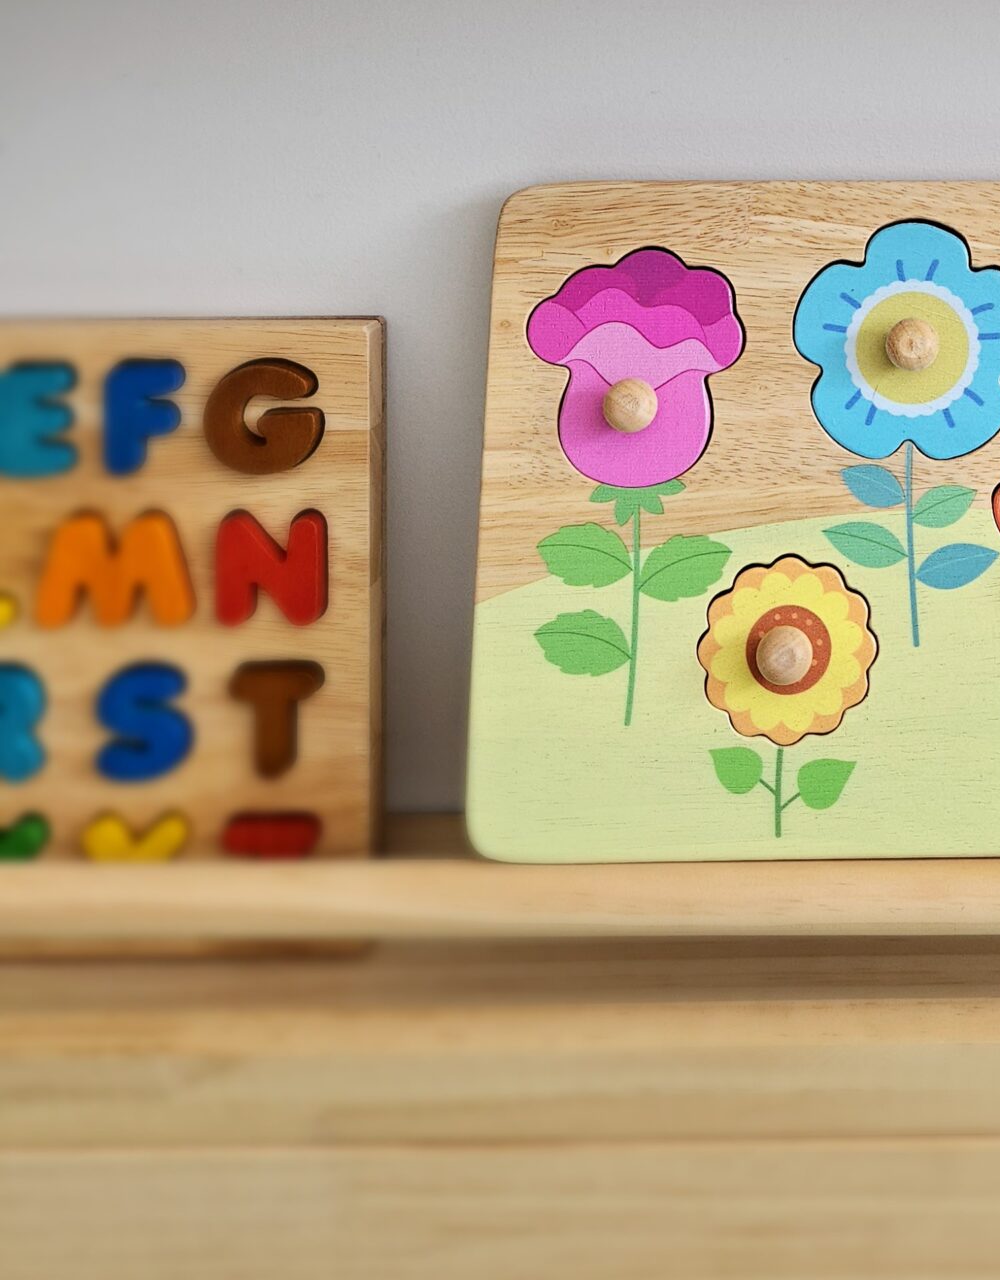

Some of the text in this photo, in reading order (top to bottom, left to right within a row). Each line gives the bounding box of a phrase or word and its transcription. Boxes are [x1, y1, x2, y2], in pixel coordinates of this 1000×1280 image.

[103, 357, 186, 478] F
[203, 357, 326, 476] G
[35, 508, 329, 631] M N
[95, 660, 195, 784] S
[228, 658, 326, 780] T
